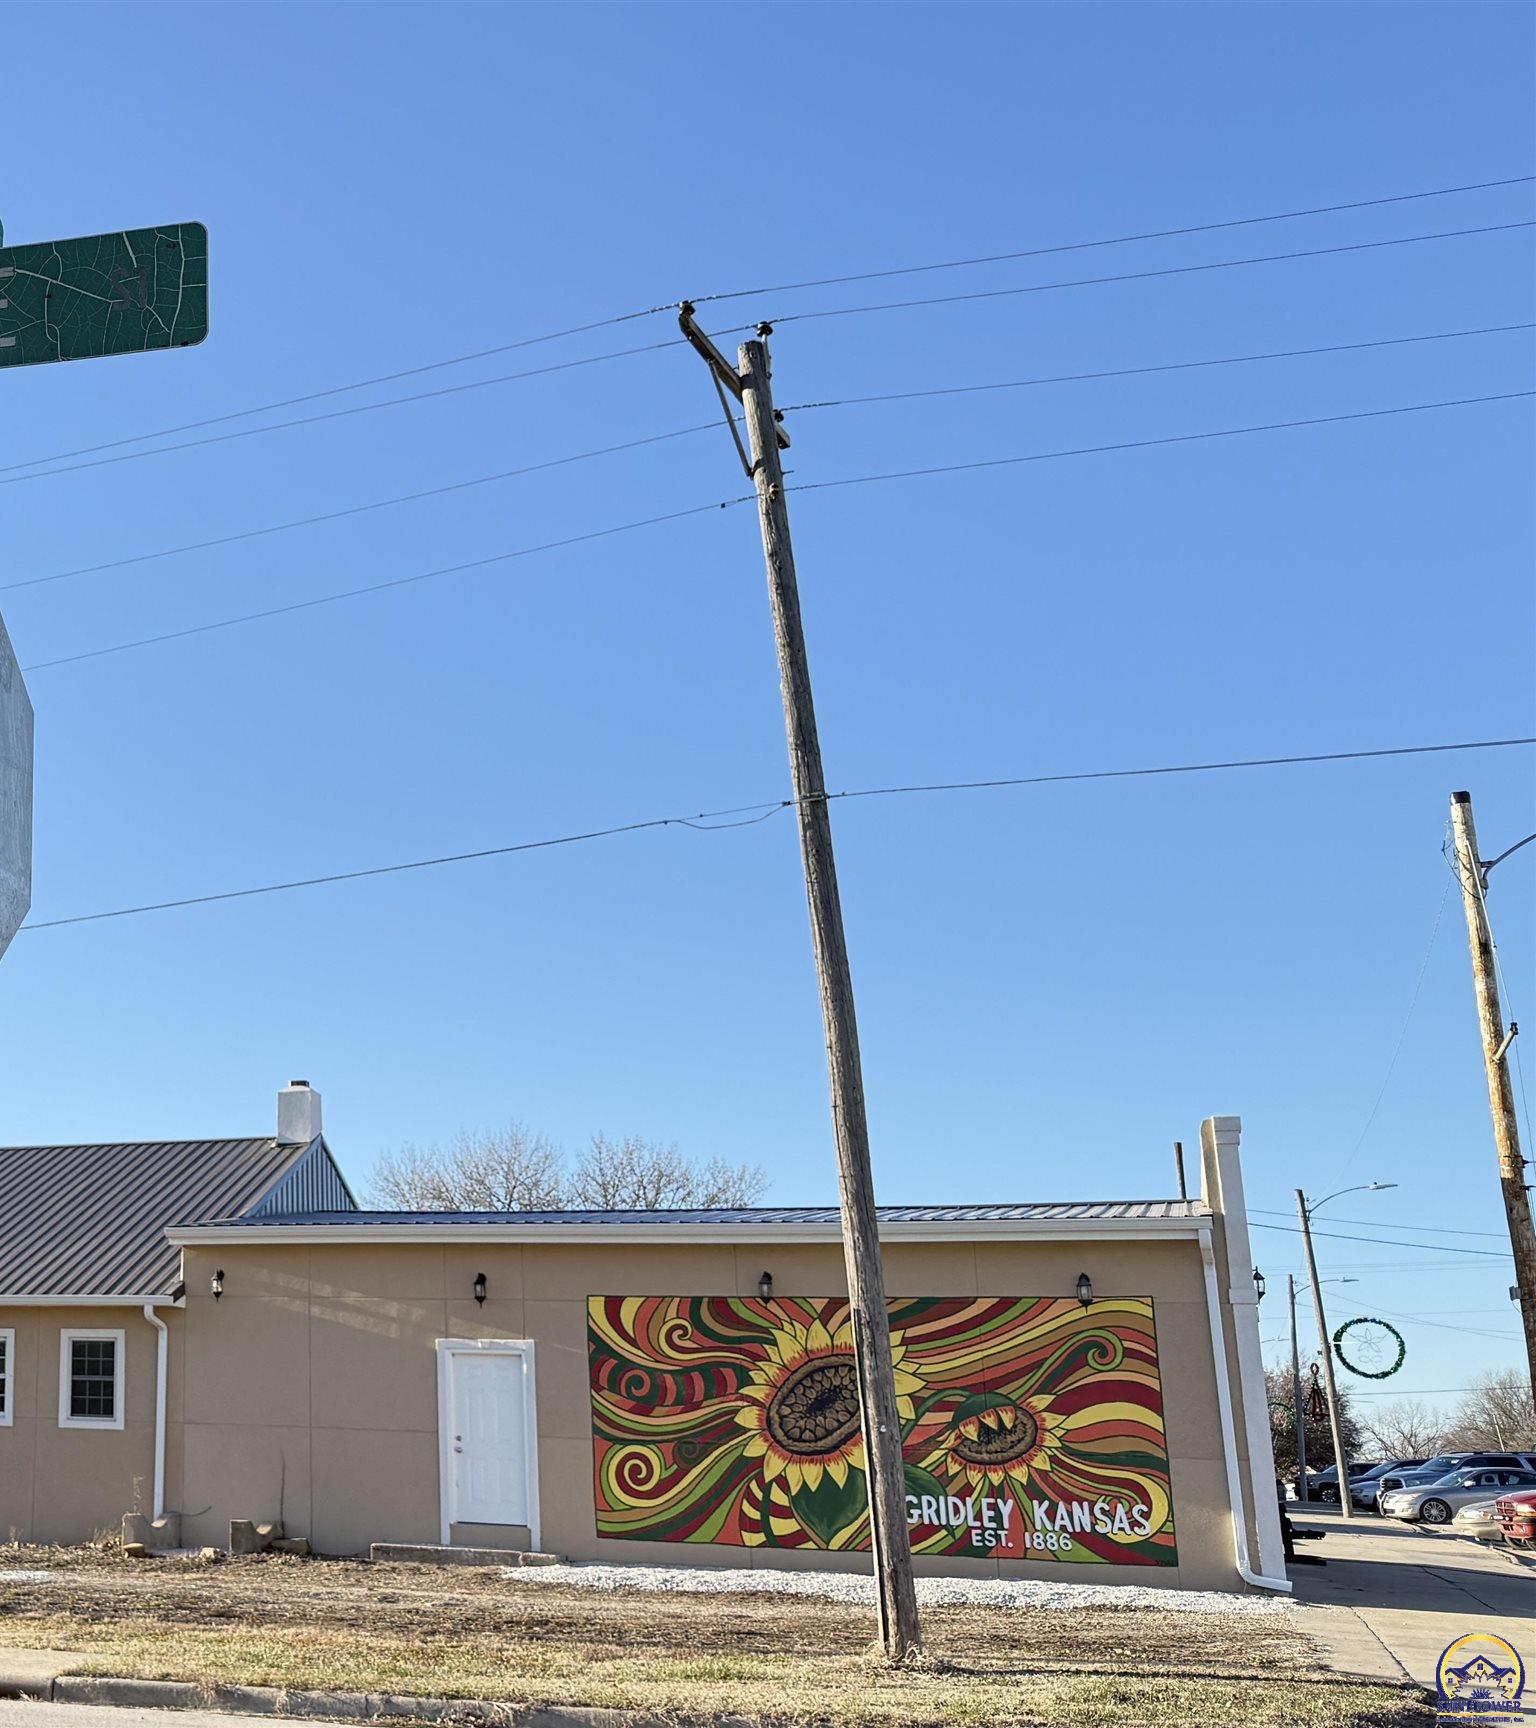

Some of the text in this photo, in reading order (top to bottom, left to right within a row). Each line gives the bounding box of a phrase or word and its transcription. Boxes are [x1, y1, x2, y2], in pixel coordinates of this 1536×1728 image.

[905, 1494, 1152, 1537] GRIDLEY KANSAS
[971, 1530, 1073, 1552] EST. 1886
